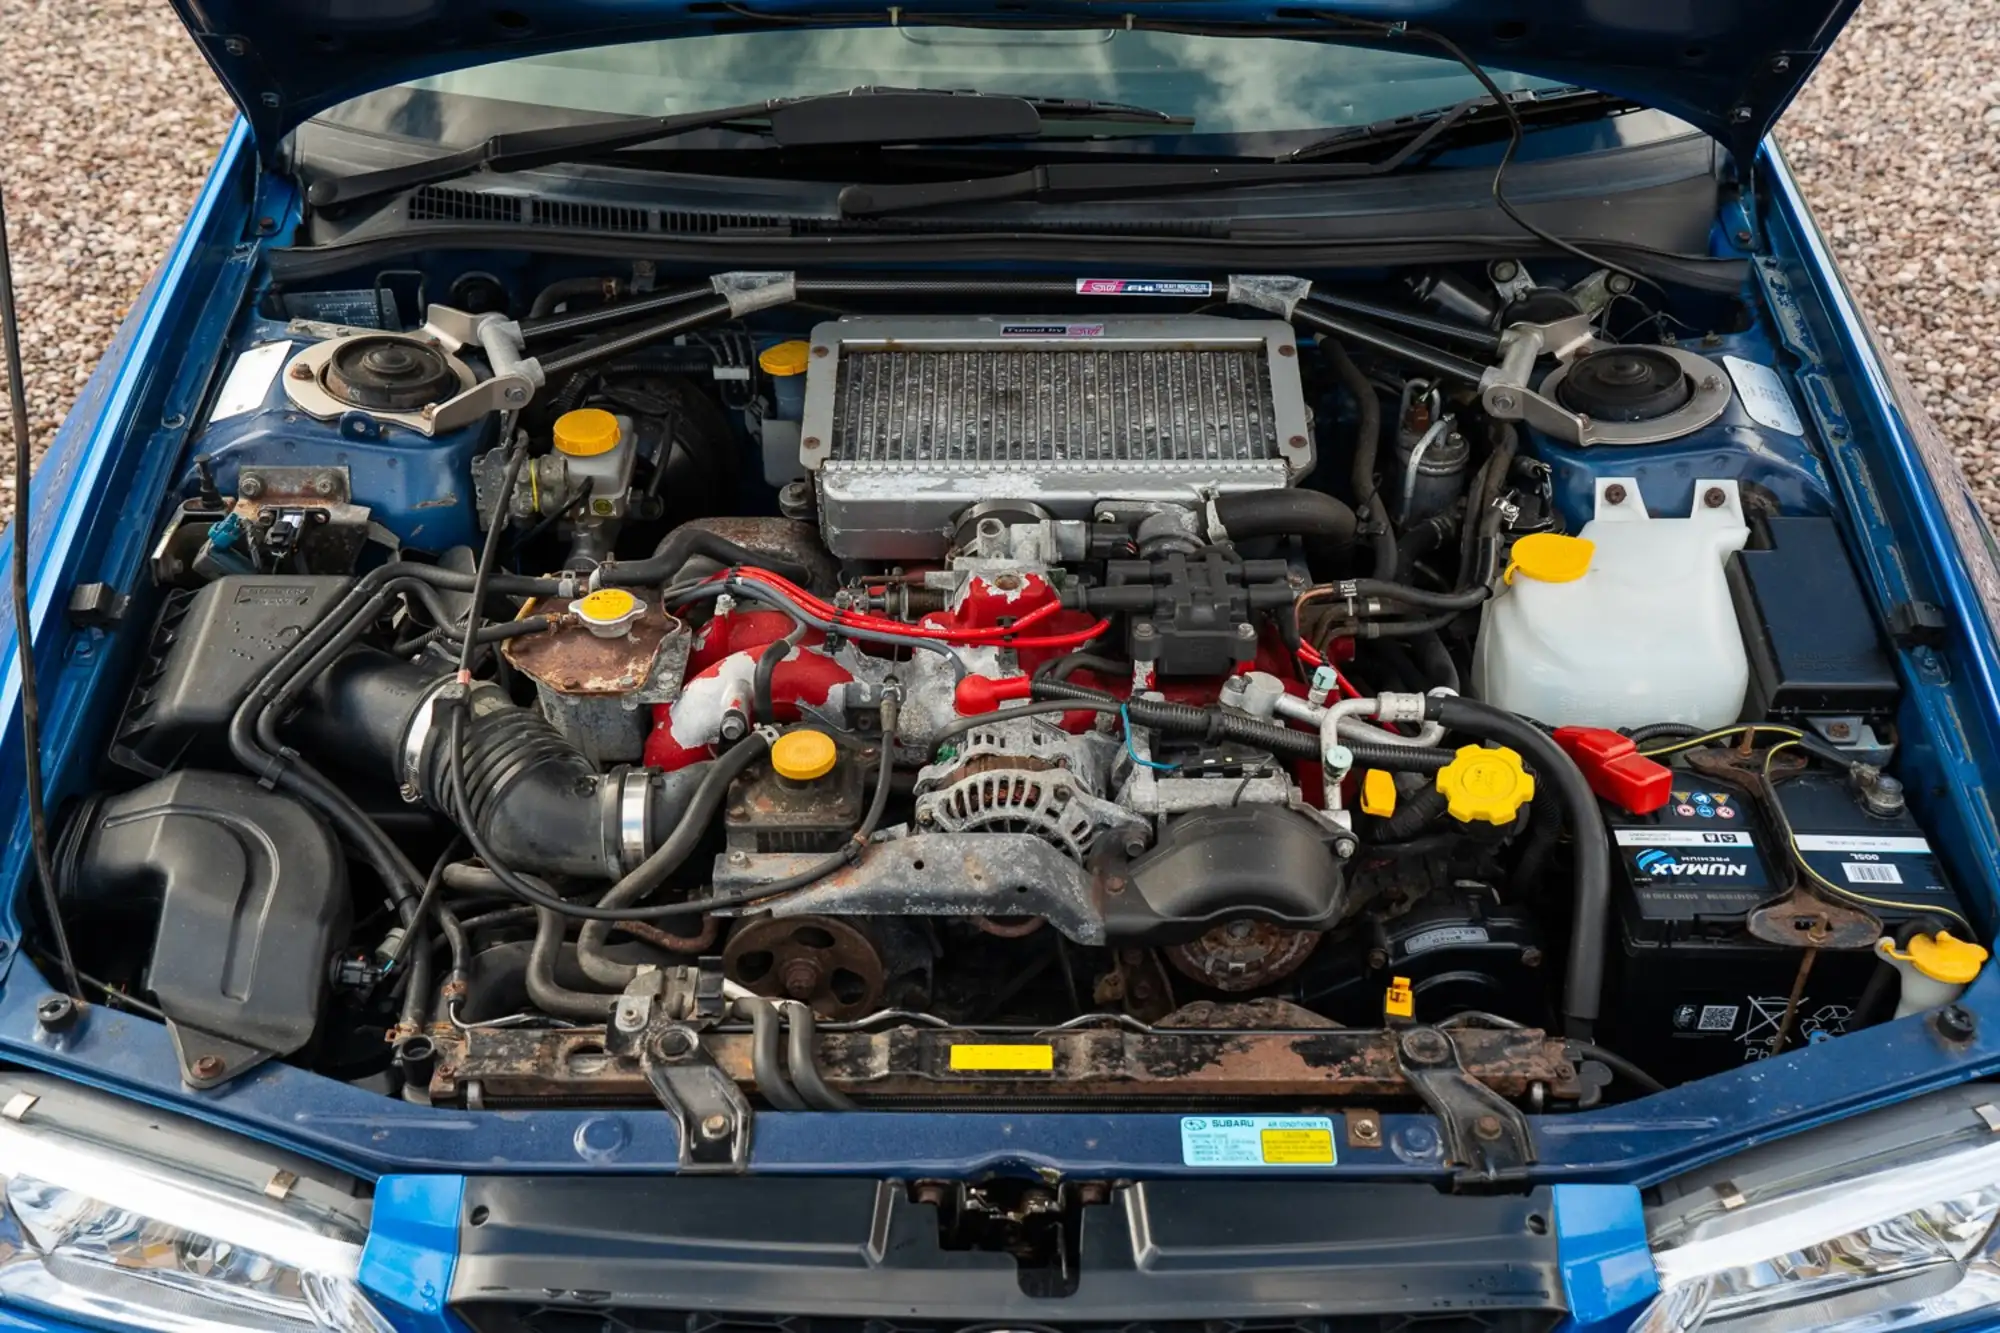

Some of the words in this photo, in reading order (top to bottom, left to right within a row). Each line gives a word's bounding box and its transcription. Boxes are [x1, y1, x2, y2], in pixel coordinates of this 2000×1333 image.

[1127, 284, 1153, 292] FHI
[1651, 863, 1748, 877] NUMAX
[1744, 1048, 1770, 1061] Pb
[1211, 1119, 1255, 1128] SUBARU
